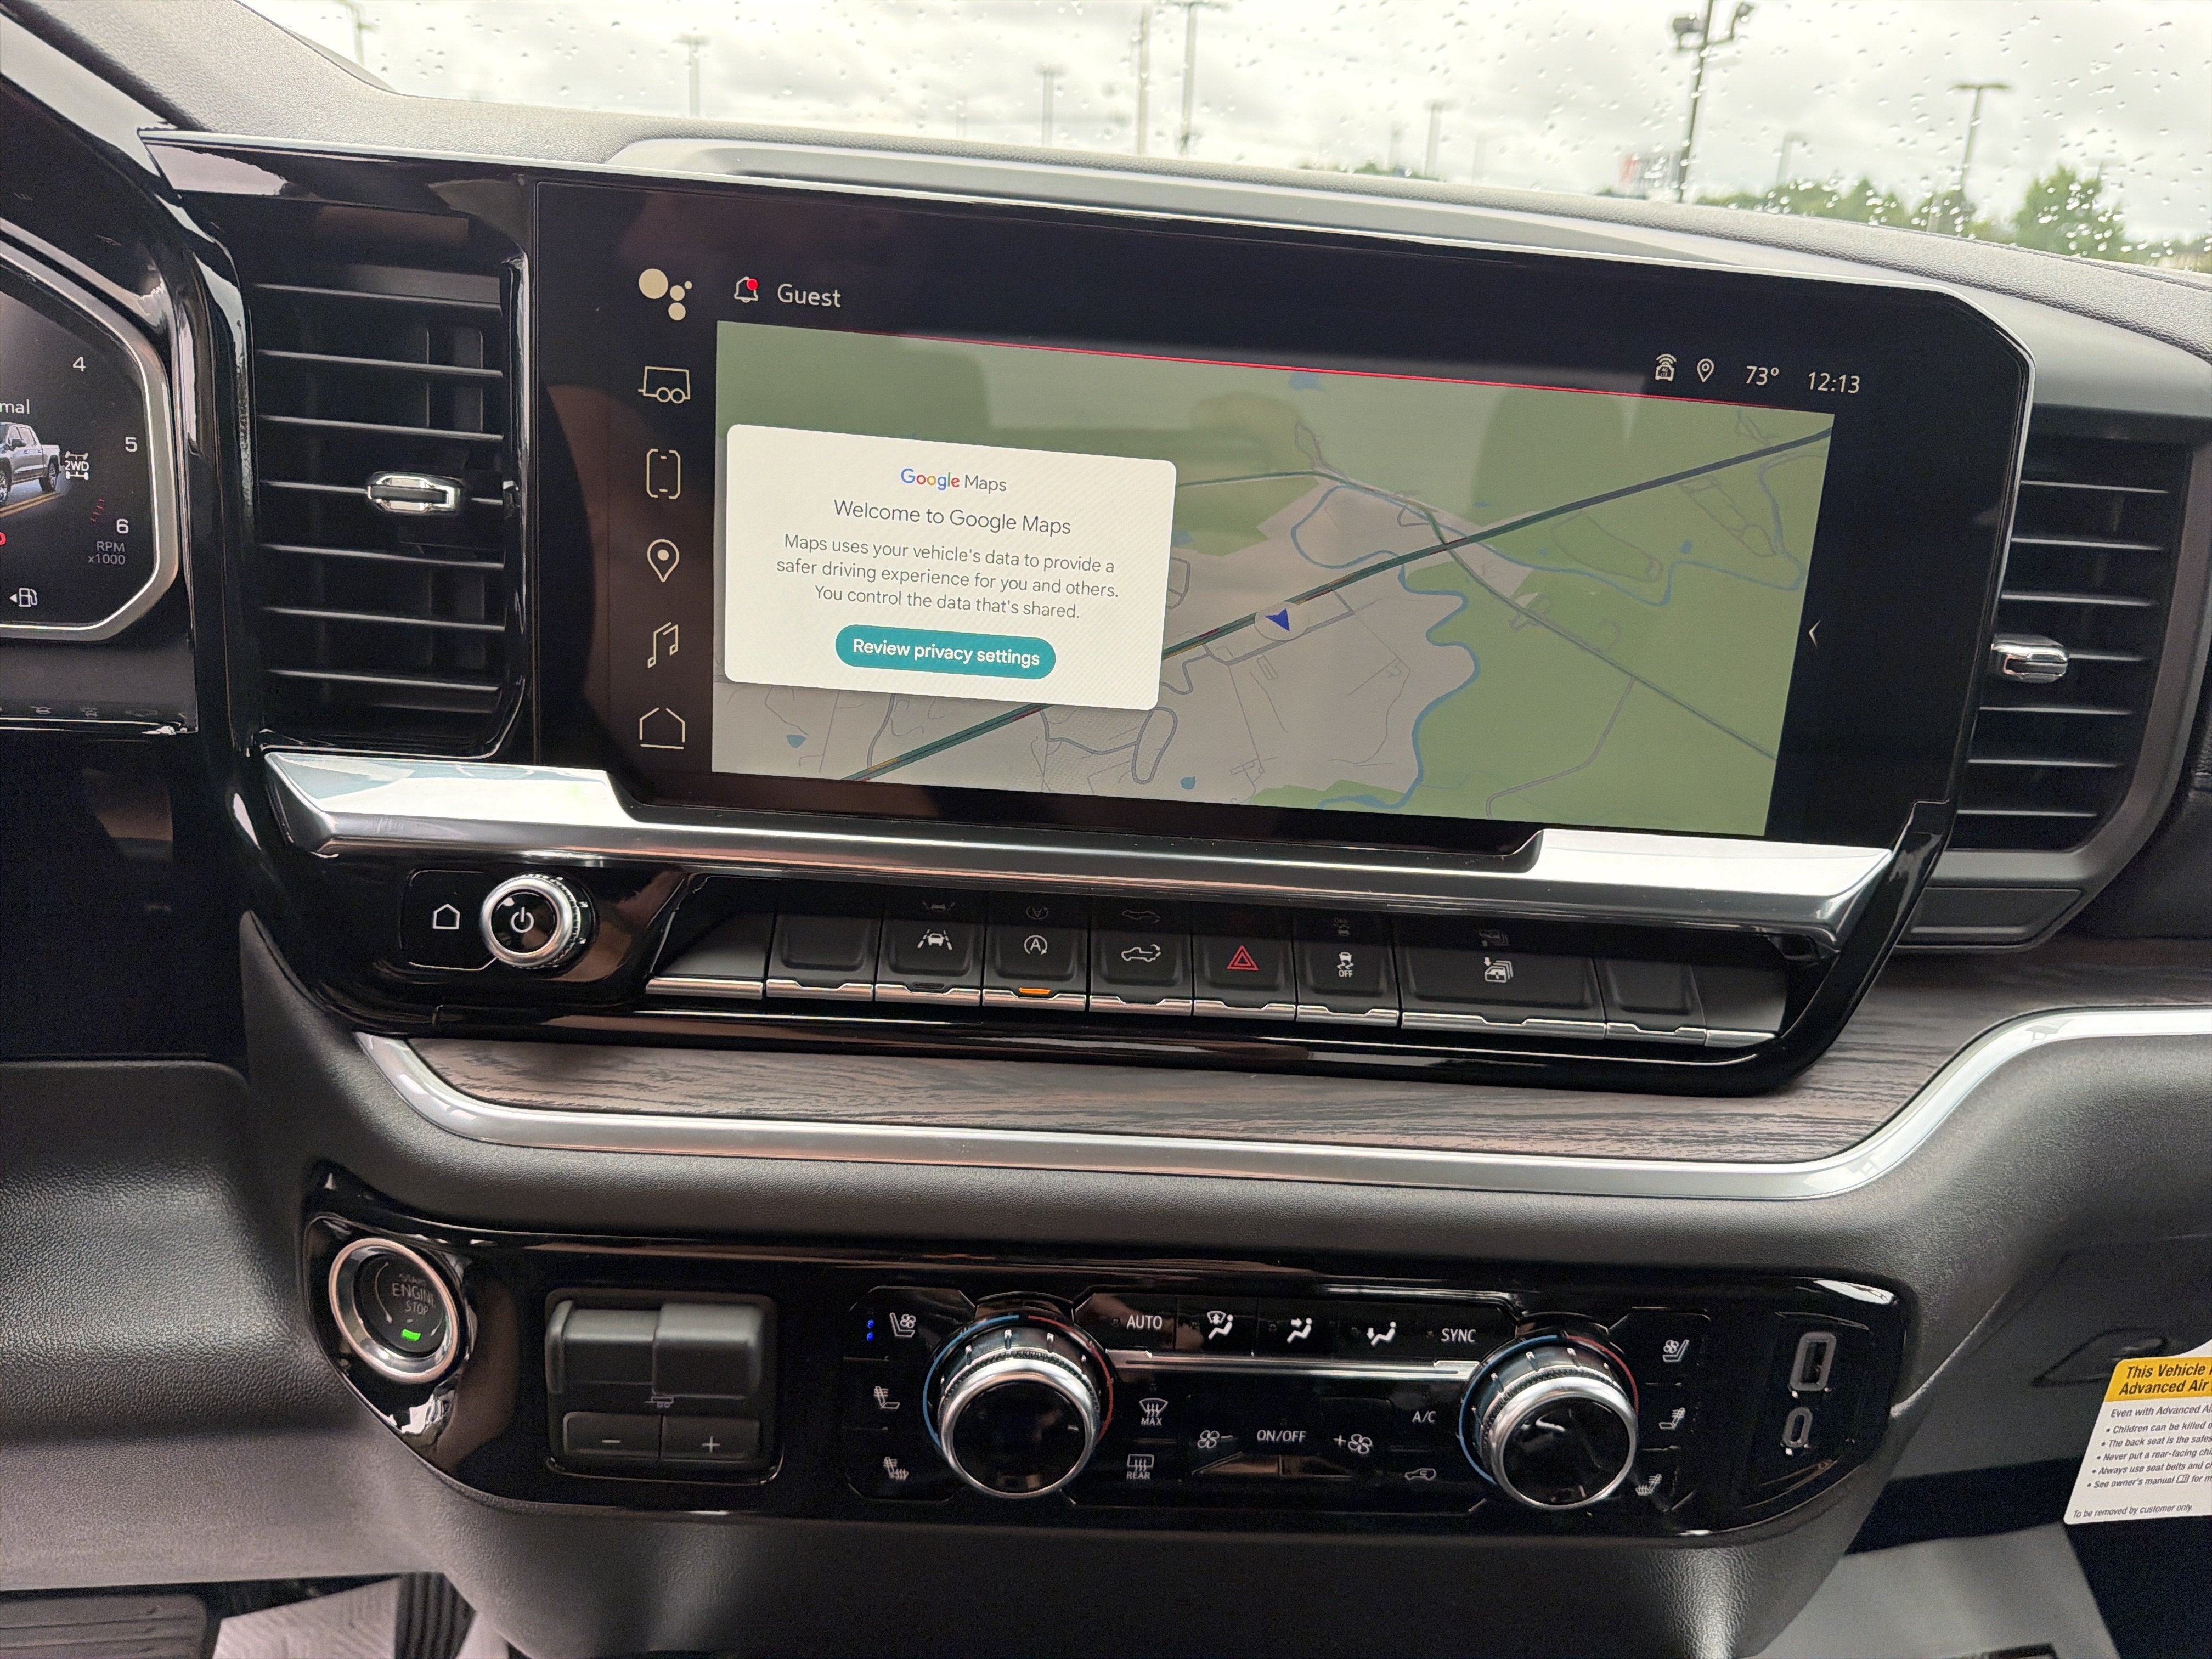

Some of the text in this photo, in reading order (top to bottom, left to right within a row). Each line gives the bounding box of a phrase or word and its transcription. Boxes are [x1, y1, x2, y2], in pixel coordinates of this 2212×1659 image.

[777, 283, 841, 308] Guest
[72, 356, 86, 372] 4
[1745, 365, 1780, 385] 73°
[1808, 371, 1860, 394] 12:13
[125, 437, 138, 452] 5
[64, 460, 89, 472] 2WD
[900, 468, 1007, 494] Google Maps
[834, 499, 1071, 537] Welcome to Google Maps
[116, 518, 129, 534] 6
[97, 541, 125, 552] RPM
[785, 534, 1114, 573] Maps uses your vehicle's data to provide a
[88, 554, 125, 565] x1000
[777, 558, 1118, 597] safer driving experience for you and others.
[815, 585, 1080, 618] You control the data that's shared.
[853, 638, 1040, 669] Review privacy settings
[1338, 969, 1353, 978] OFF
[404, 1300, 429, 1315] STOP
[1126, 1314, 1163, 1330] AUTO
[1441, 1328, 1477, 1344] SYNC
[2126, 1364, 2153, 1379] This
[2158, 1363, 2206, 1377] Vehicle
[2118, 1379, 2187, 1395] Advanced
[2187, 1379, 2209, 1392] Air
[1412, 1410, 1436, 1425] A/C
[2110, 1409, 2132, 1418] Even
[2135, 1407, 2154, 1416] with
[2155, 1404, 2201, 1415] Advanced
[1141, 1417, 1163, 1426] MAX
[2113, 1425, 2148, 1434] Children
[2151, 1424, 2166, 1432] can
[2169, 1423, 2180, 1431] be
[2182, 1421, 2207, 1430] killed
[1256, 1430, 1307, 1443] ON/OFF
[2109, 1440, 2123, 1448] The
[2125, 1438, 2145, 1446] back
[2146, 1436, 2165, 1445] seat
[2166, 1436, 2174, 1444] is
[2176, 1435, 2190, 1444] the
[2103, 1453, 2128, 1462] Never
[2128, 1451, 2143, 1462] put
[2152, 1448, 2198, 1458] rear-facing
[1126, 1470, 1150, 1480] REAR
[2098, 1466, 2128, 1475] Always
[2129, 1465, 2145, 1474] use
[2146, 1463, 2165, 1472] seat
[2165, 1462, 2186, 1471] belts
[2187, 1462, 2204, 1470] and
[2094, 1480, 2109, 1488] See
[2111, 1477, 2143, 1487] owner's
[2145, 1475, 2176, 1485] manual
[2191, 1474, 2204, 1483] for
[2073, 1503, 2193, 1519] To be removed by customer only.
